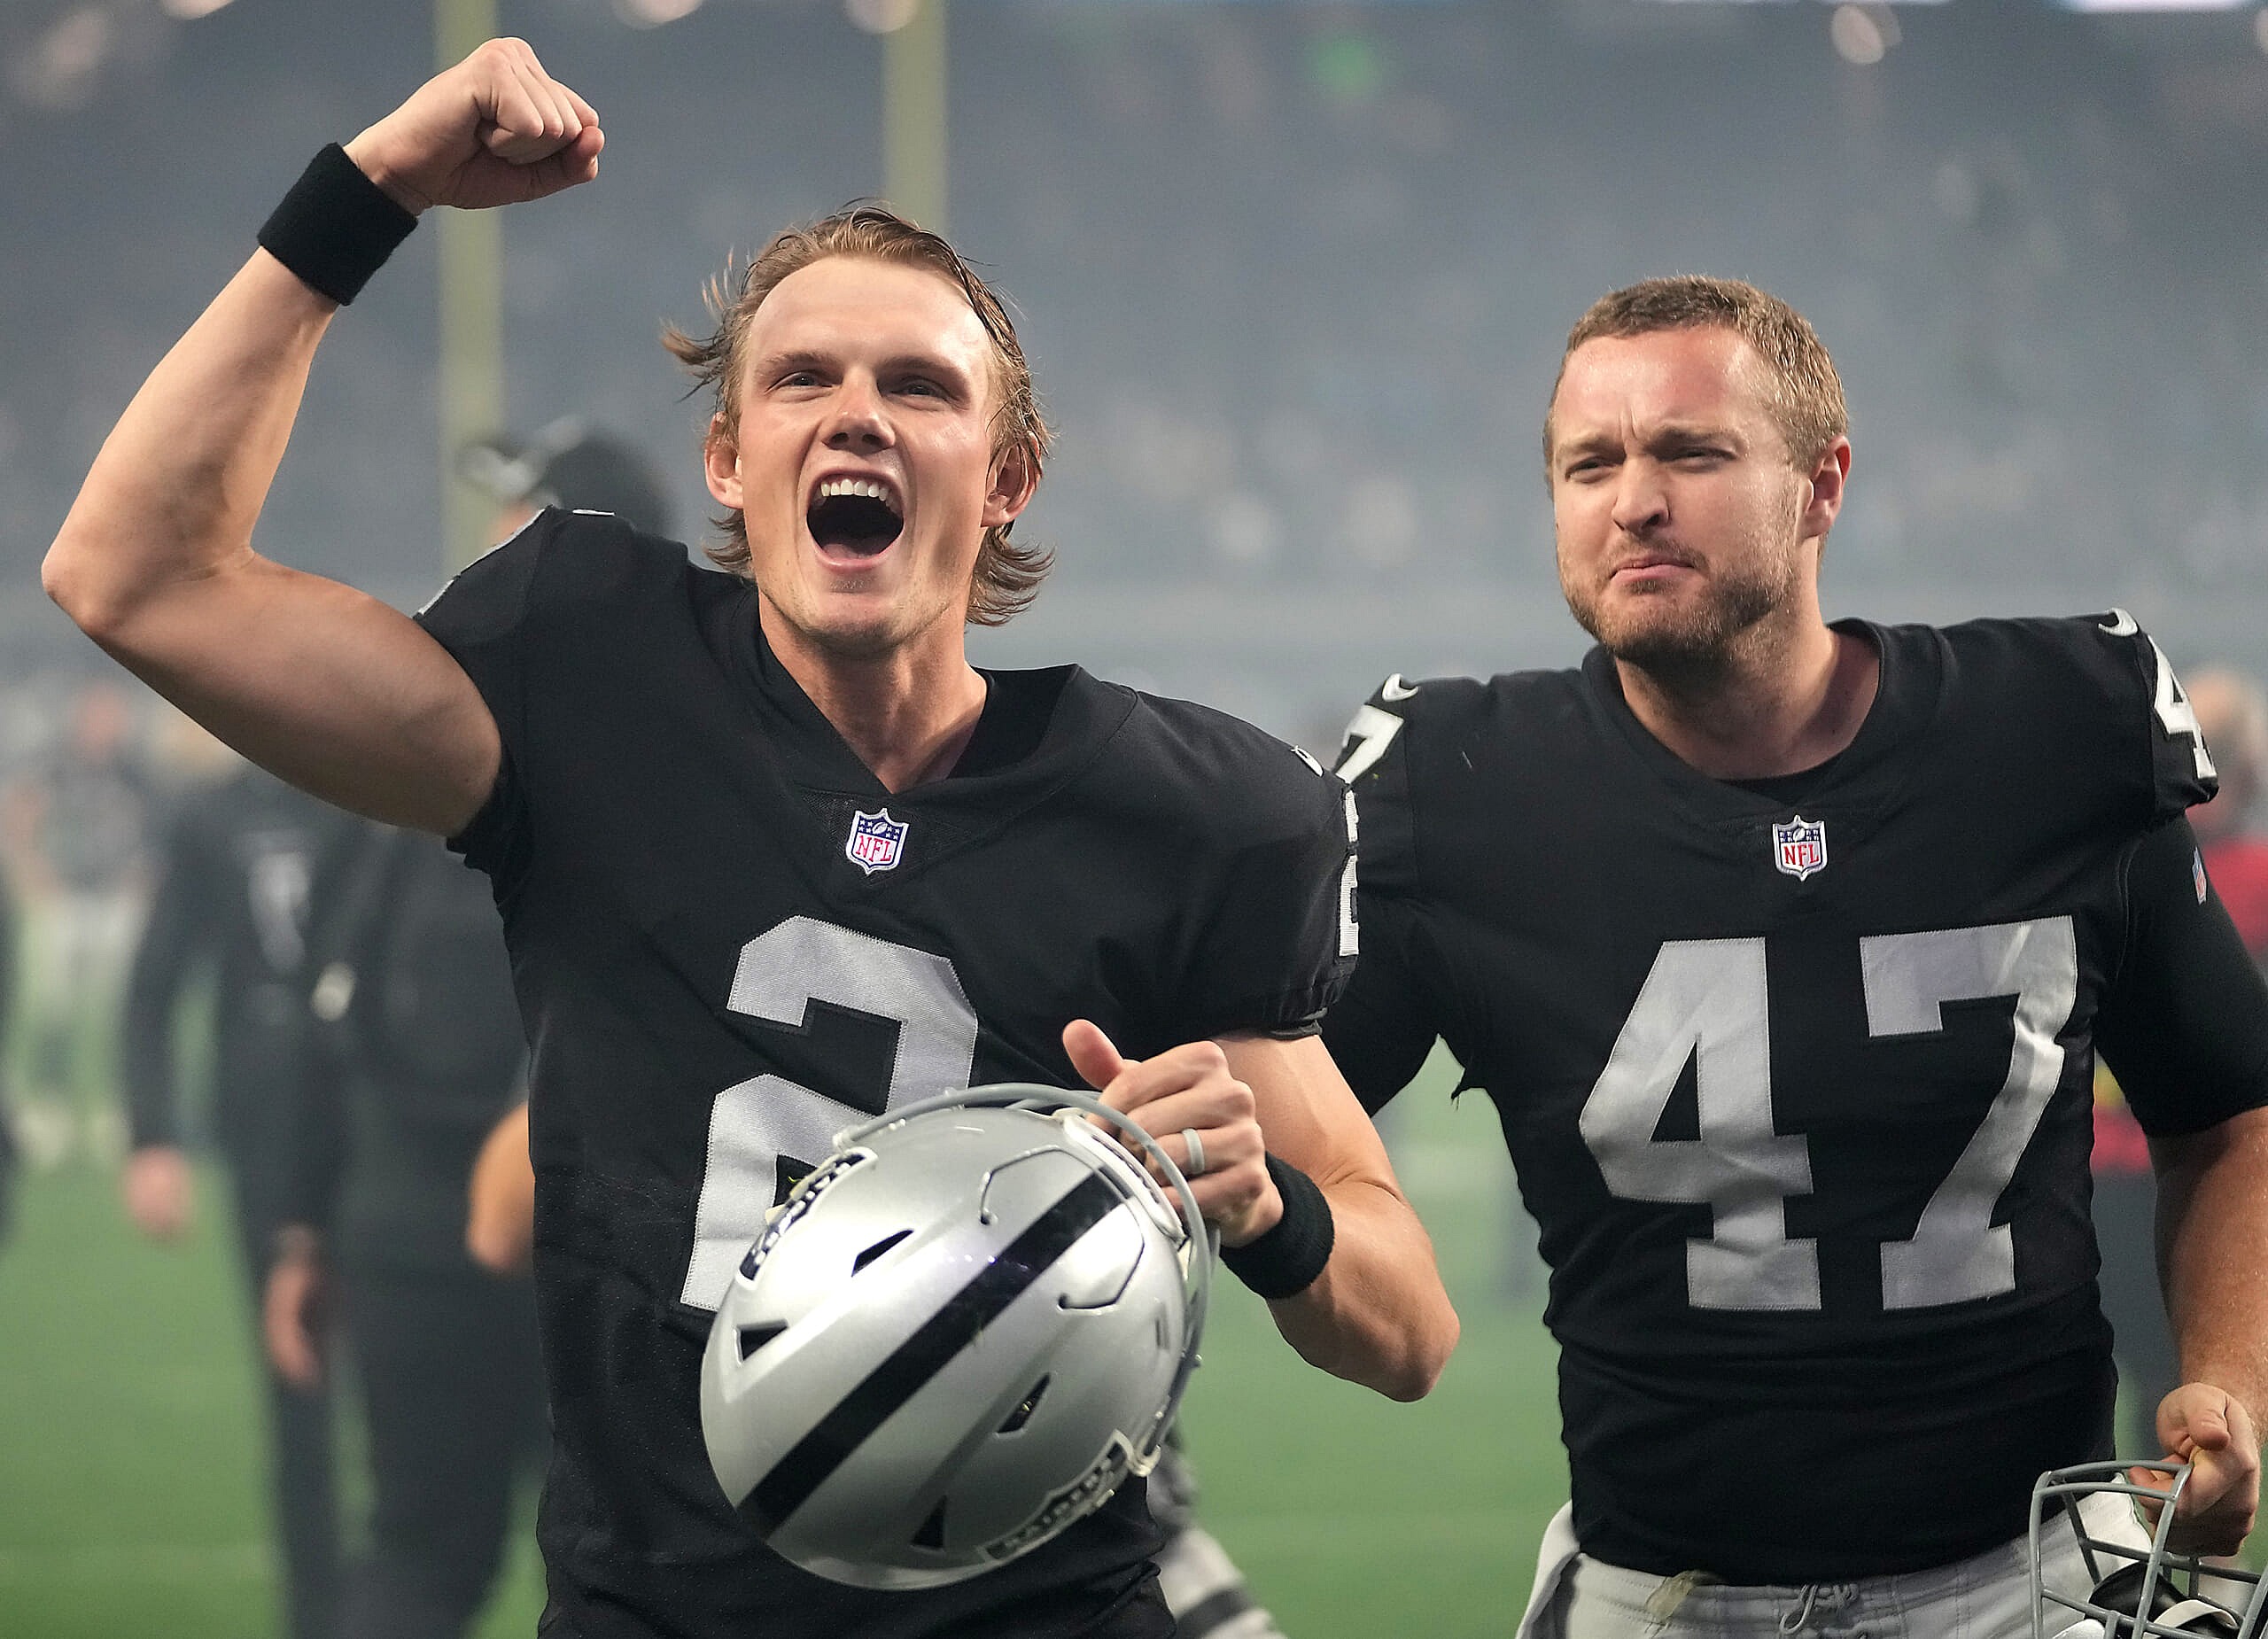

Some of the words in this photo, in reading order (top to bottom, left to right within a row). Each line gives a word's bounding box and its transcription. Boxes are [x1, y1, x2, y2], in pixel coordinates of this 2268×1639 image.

[855, 835, 892, 863] NFL
[1783, 843, 1820, 867] NFL
[680, 914, 978, 1312] 2
[1579, 915, 2078, 1311] 47
